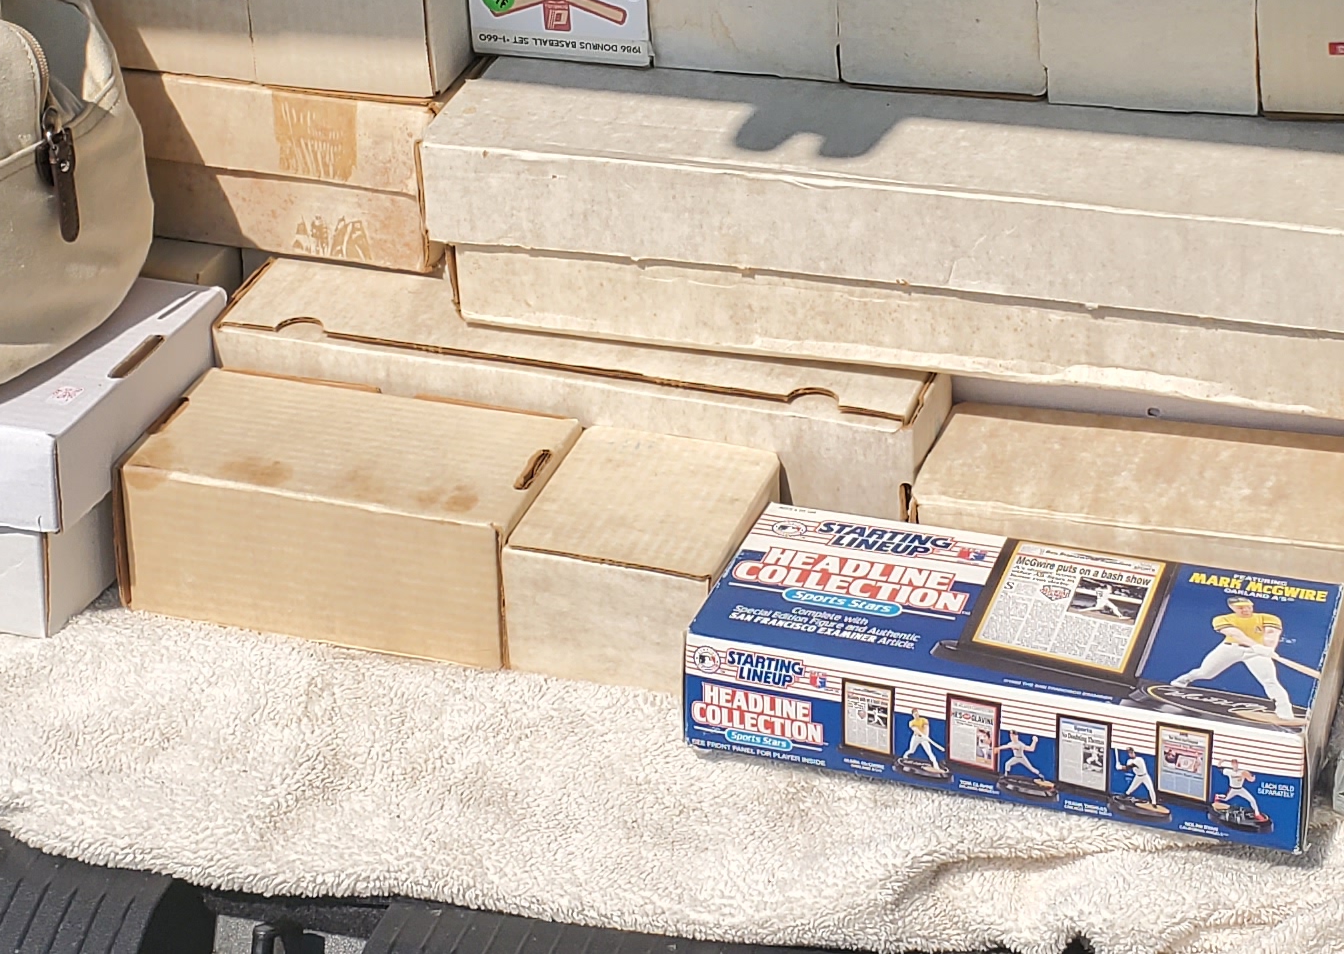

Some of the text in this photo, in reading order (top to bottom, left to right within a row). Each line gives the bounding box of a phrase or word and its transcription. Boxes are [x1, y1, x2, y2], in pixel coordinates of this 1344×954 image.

[513, 36, 529, 45] SET
[532, 37, 576, 49] BASEBALL
[579, 42, 618, 52] DONRUS
[621, 46, 641, 54] 1986
[818, 521, 954, 550] STARTING
[831, 535, 933, 557] LINEUP
[761, 548, 955, 590] HEADLINE
[1016, 557, 1056, 571] McGwire
[1057, 564, 1077, 576] puts
[1079, 568, 1091, 576] on
[1092, 570, 1100, 578] a
[1101, 569, 1124, 582] bash
[1126, 574, 1152, 586] show
[1233, 574, 1288, 586] FEATURING
[732, 561, 970, 614] COLLECTION
[1189, 572, 1329, 602] MARK McGWIRE
[1223, 588, 1270, 599] OAKLAND
[792, 590, 892, 614] Sports Stars
[733, 605, 920, 642] Special Edition Figure and Authentic
[792, 607, 868, 625] Complete with
[729, 612, 915, 649] SAN FRANCISCO EXAMINER Article.
[727, 650, 805, 675] STARTING
[737, 666, 794, 687] LINEUP
[703, 682, 811, 722] HEADLINE
[692, 701, 823, 745] COLLECTION
[731, 731, 786, 748] Sports Stars
[692, 738, 826, 767] SEE FRONT PANEL FOR PLAYER INSIDE
[1258, 788, 1295, 798] SEPARATELY
[1260, 782, 1295, 792] EACH SOLD
